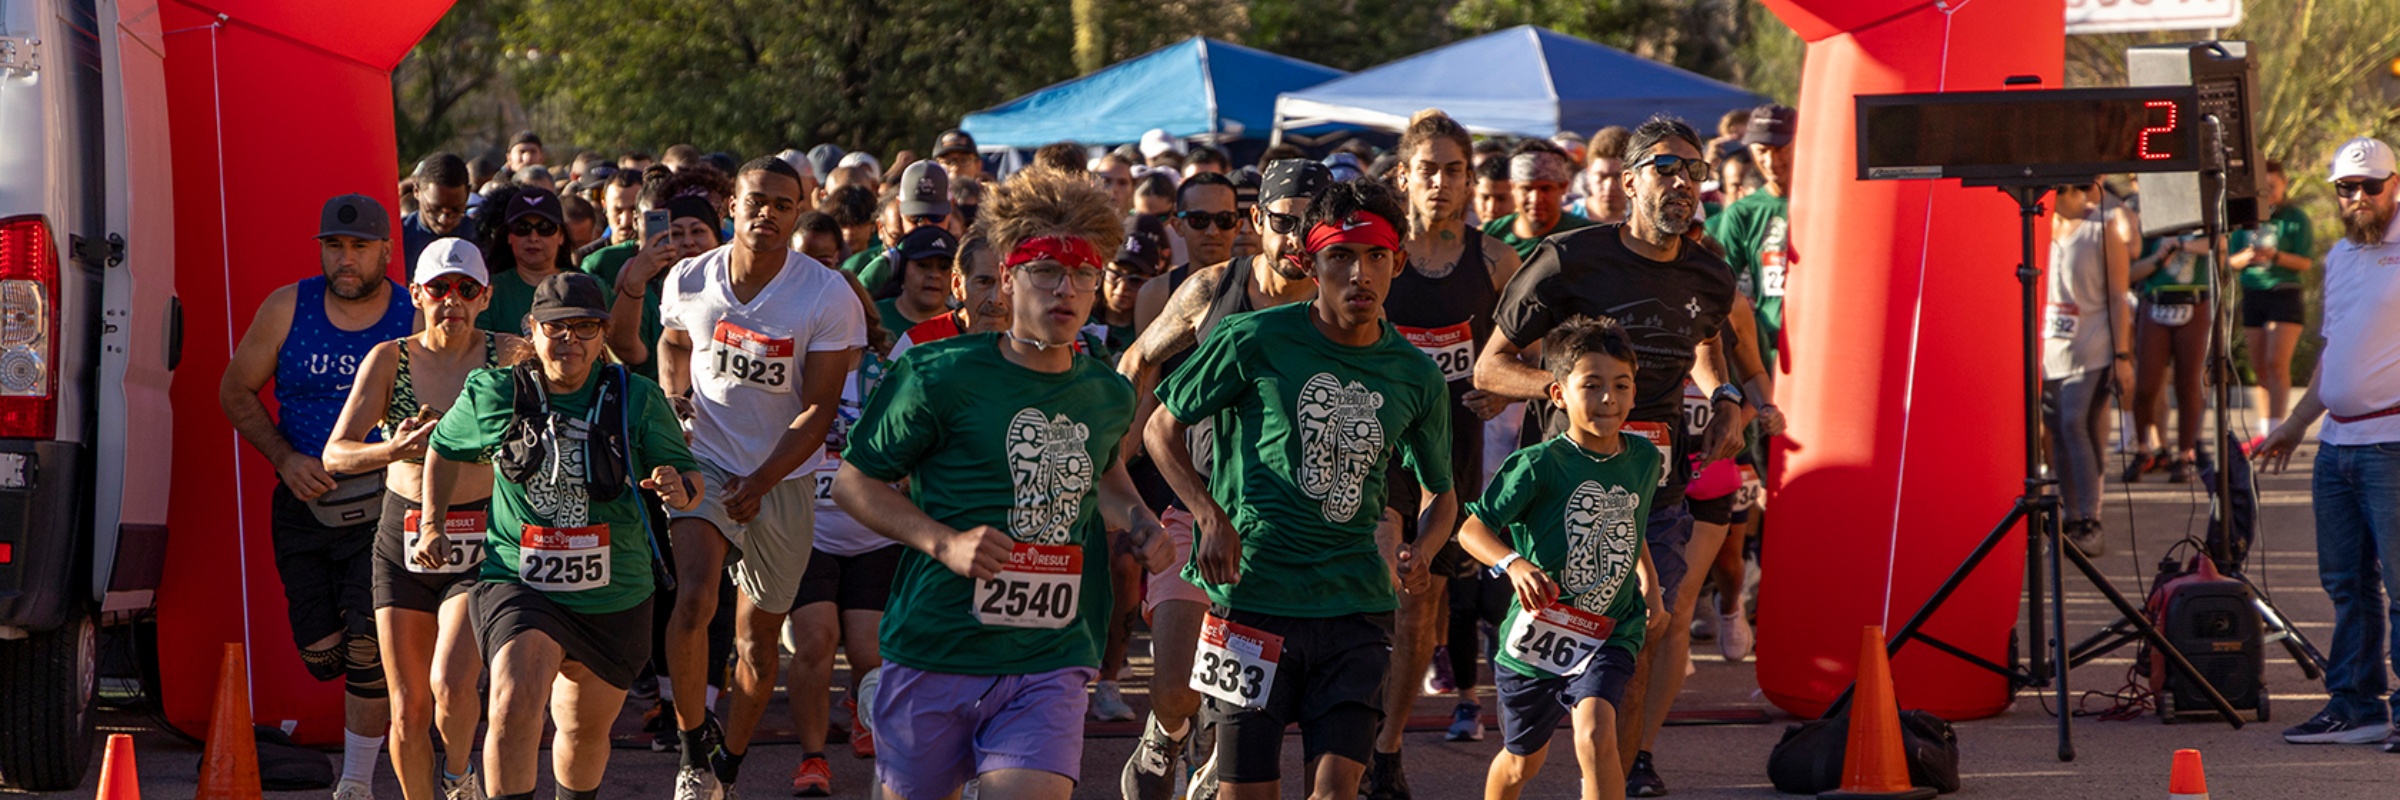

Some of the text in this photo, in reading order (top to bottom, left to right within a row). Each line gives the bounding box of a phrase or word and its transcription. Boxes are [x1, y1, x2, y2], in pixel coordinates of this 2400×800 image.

[2138, 100, 2177, 160] 2
[716, 349, 786, 387] 1923
[1426, 347, 1469, 375] 26
[1683, 403, 1714, 429] 50
[1308, 467, 1333, 486] 5K
[1017, 509, 1046, 528] 5K
[532, 533, 555, 544] RACE
[525, 553, 604, 584] 2255
[1009, 552, 1071, 567] ACE RESULT
[1569, 569, 1594, 585] 5K
[980, 578, 1073, 619] 2540
[1567, 614, 1601, 632] RESULT
[1516, 623, 1597, 668] 2467
